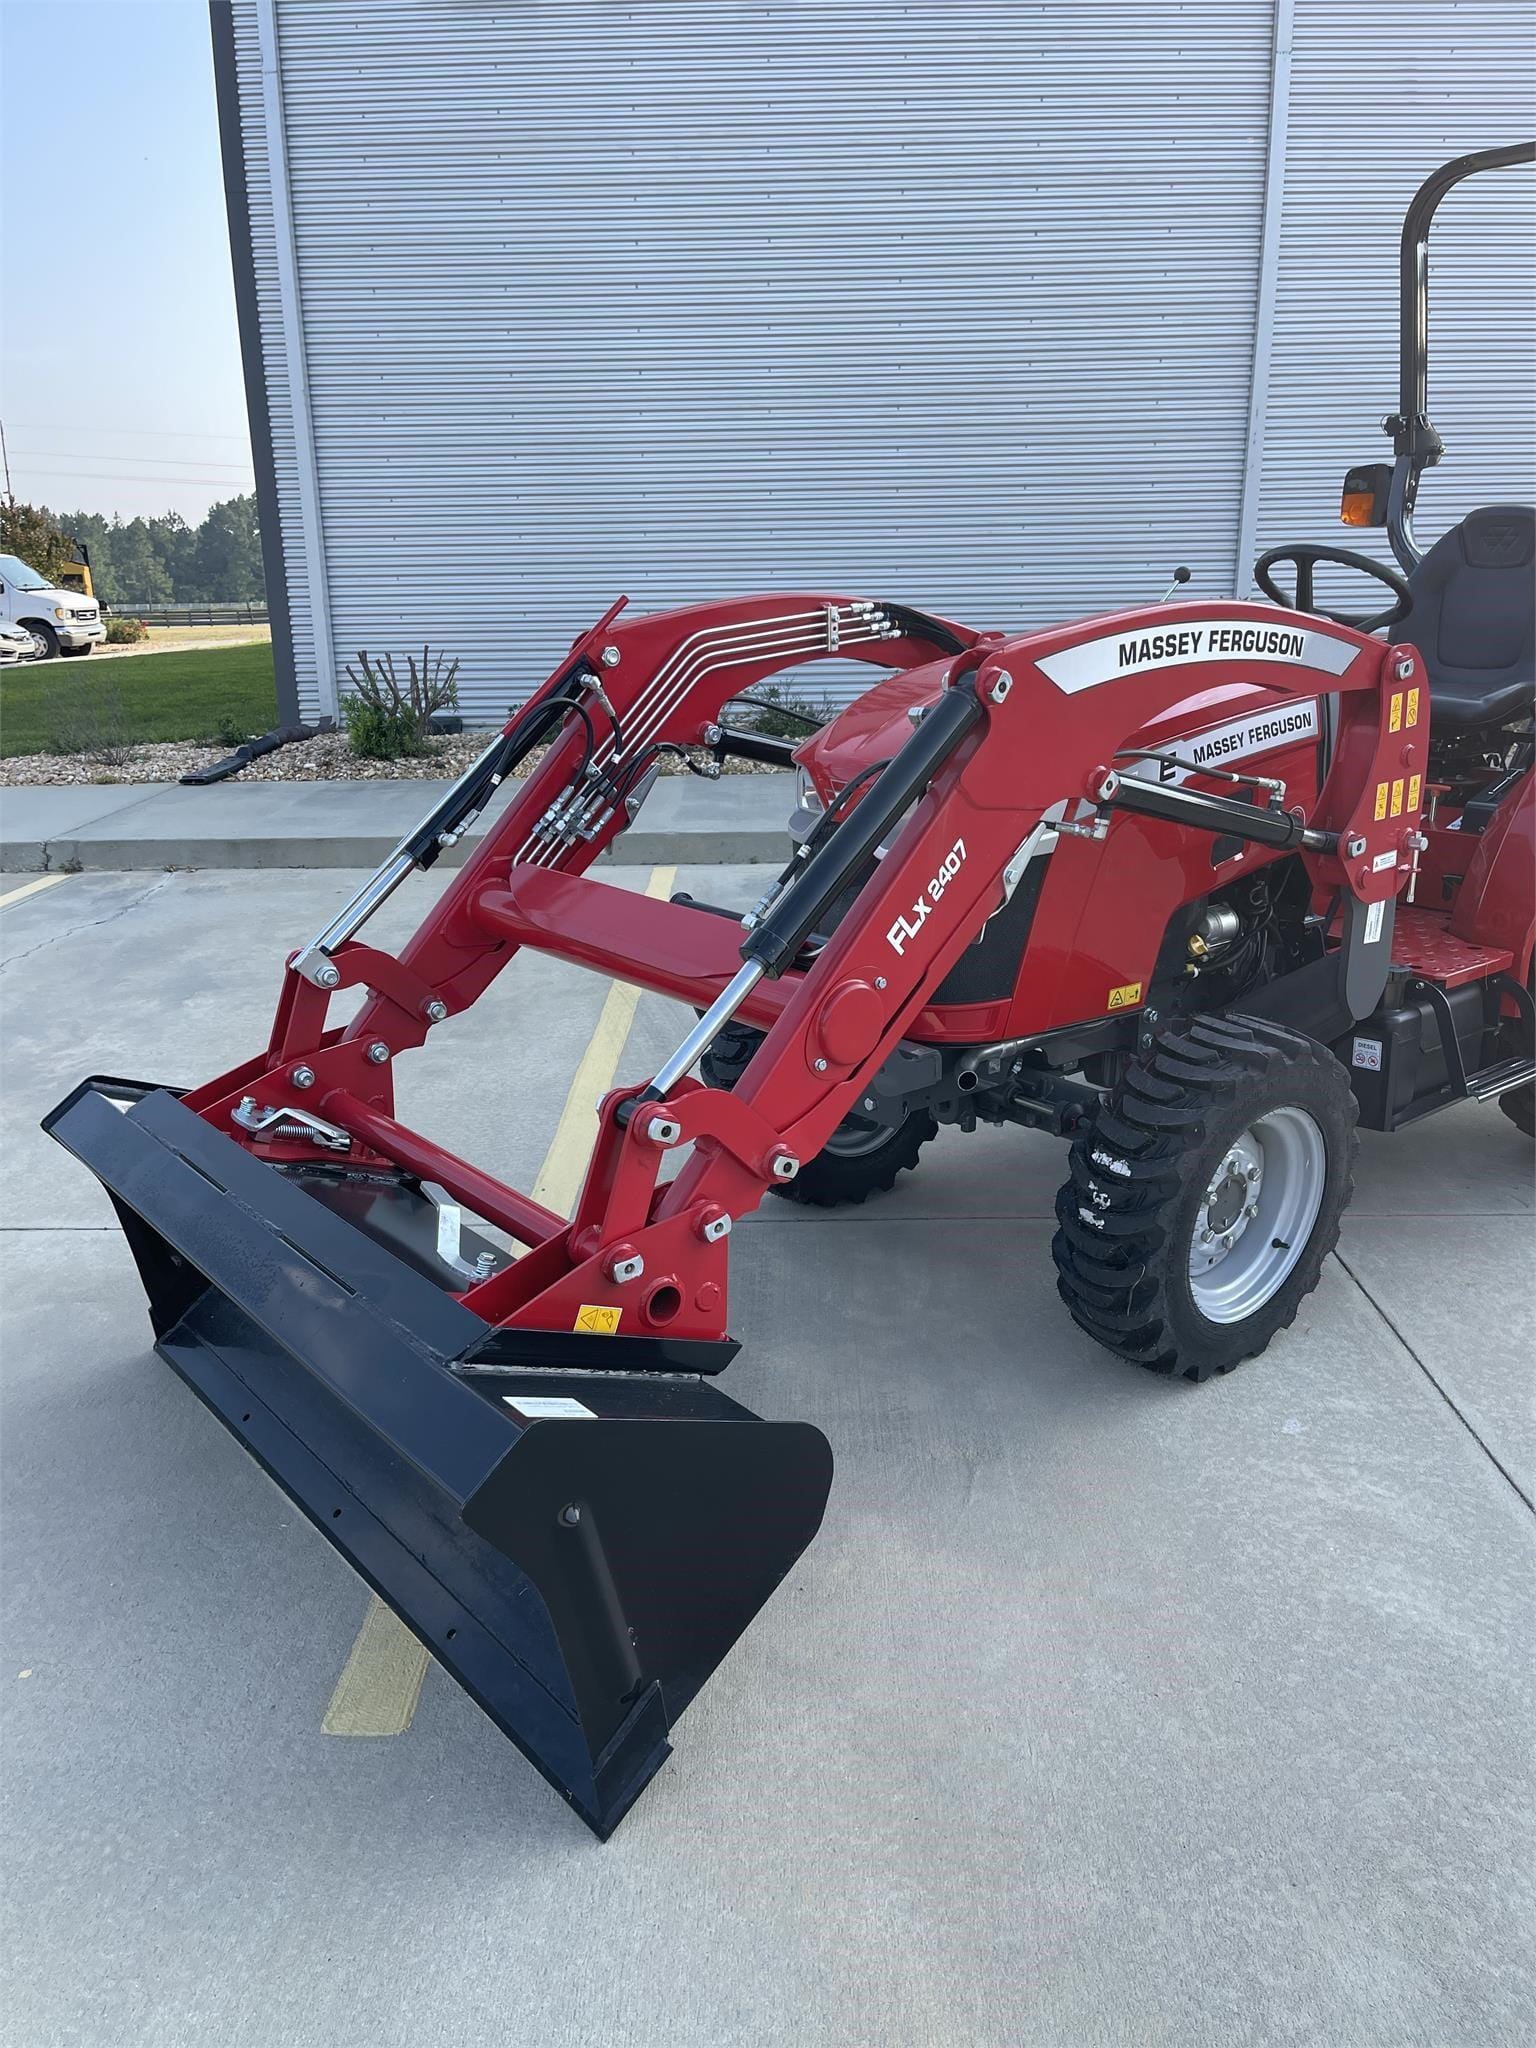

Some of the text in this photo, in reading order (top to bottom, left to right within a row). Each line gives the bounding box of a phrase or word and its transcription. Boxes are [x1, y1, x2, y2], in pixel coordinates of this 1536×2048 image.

[1119, 629, 1304, 667] MASSEY FERGUSON
[1193, 711, 1312, 764] MASSEY FERGUSON
[927, 837, 967, 902] 2407
[1358, 1041, 1377, 1051] DIESEL
